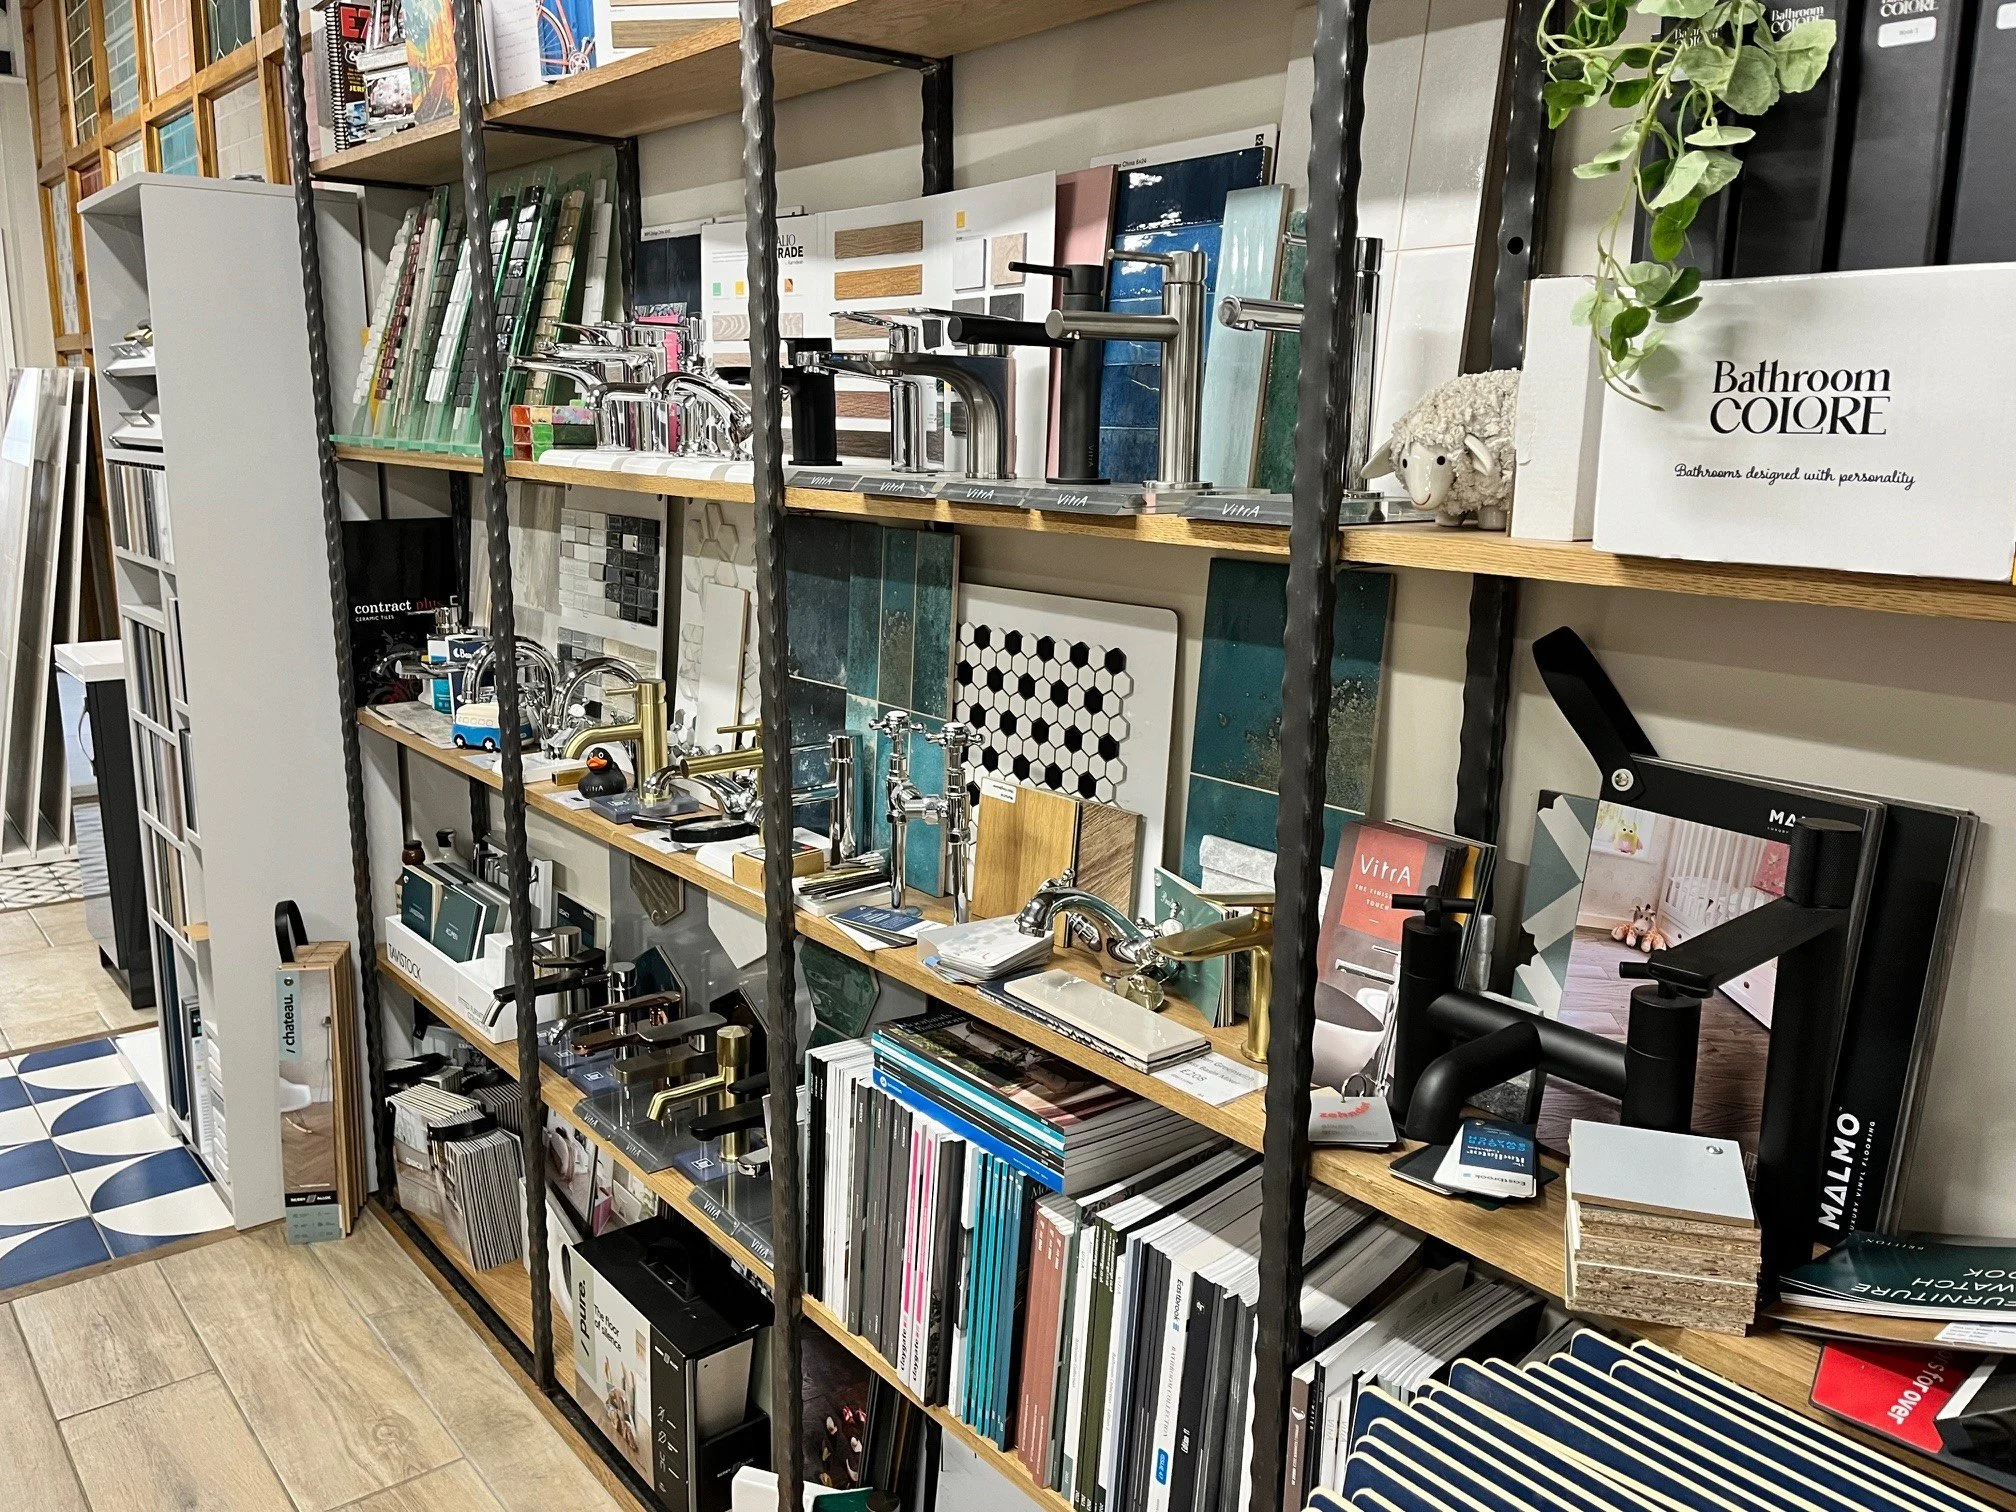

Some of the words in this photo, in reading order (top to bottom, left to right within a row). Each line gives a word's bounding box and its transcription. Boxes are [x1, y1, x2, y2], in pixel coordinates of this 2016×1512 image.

[1771, 5, 1824, 22] Bathroom
[778, 246, 804, 258] RADE
[1712, 359, 1891, 394] Bathroom
[1710, 395, 1891, 435] COLORE
[810, 476, 832, 486] VitrA
[879, 481, 905, 493] VitrA
[1674, 463, 1742, 479] Bathrooms
[1745, 465, 1800, 486] designed
[1803, 467, 1836, 481] with
[1838, 469, 1916, 491] personality
[966, 487, 995, 500] VitrA
[1057, 493, 1089, 507] VitrA
[1221, 502, 1261, 518] VitrA
[354, 600, 412, 615] contract
[355, 615, 380, 623] CERAMIC
[380, 614, 395, 622] TILES
[1361, 853, 1411, 888] VitrA
[1354, 883, 1368, 893] THE
[1366, 898, 1390, 911] TOUCH
[282, 993, 296, 1047] chateau.
[584, 1111, 599, 1127] VitrA
[625, 1141, 641, 1157] VitrA
[1855, 1172, 1866, 1197] VINYL
[1862, 1121, 1876, 1167] FLOORING
[1818, 1113, 1860, 1231] MALMO
[703, 1200, 721, 1221] VitrA
[752, 1238, 769, 1258] VitrA
[579, 1279, 591, 1340] pure.
[1174, 1278, 1184, 1322] Eastbrook
[593, 1303, 606, 1319] The
[604, 1311, 620, 1337] floor
[1912, 1369, 1944, 1394] for
[1163, 1390, 1173, 1437] COLLECTION
[1887, 1389, 1922, 1425] over
